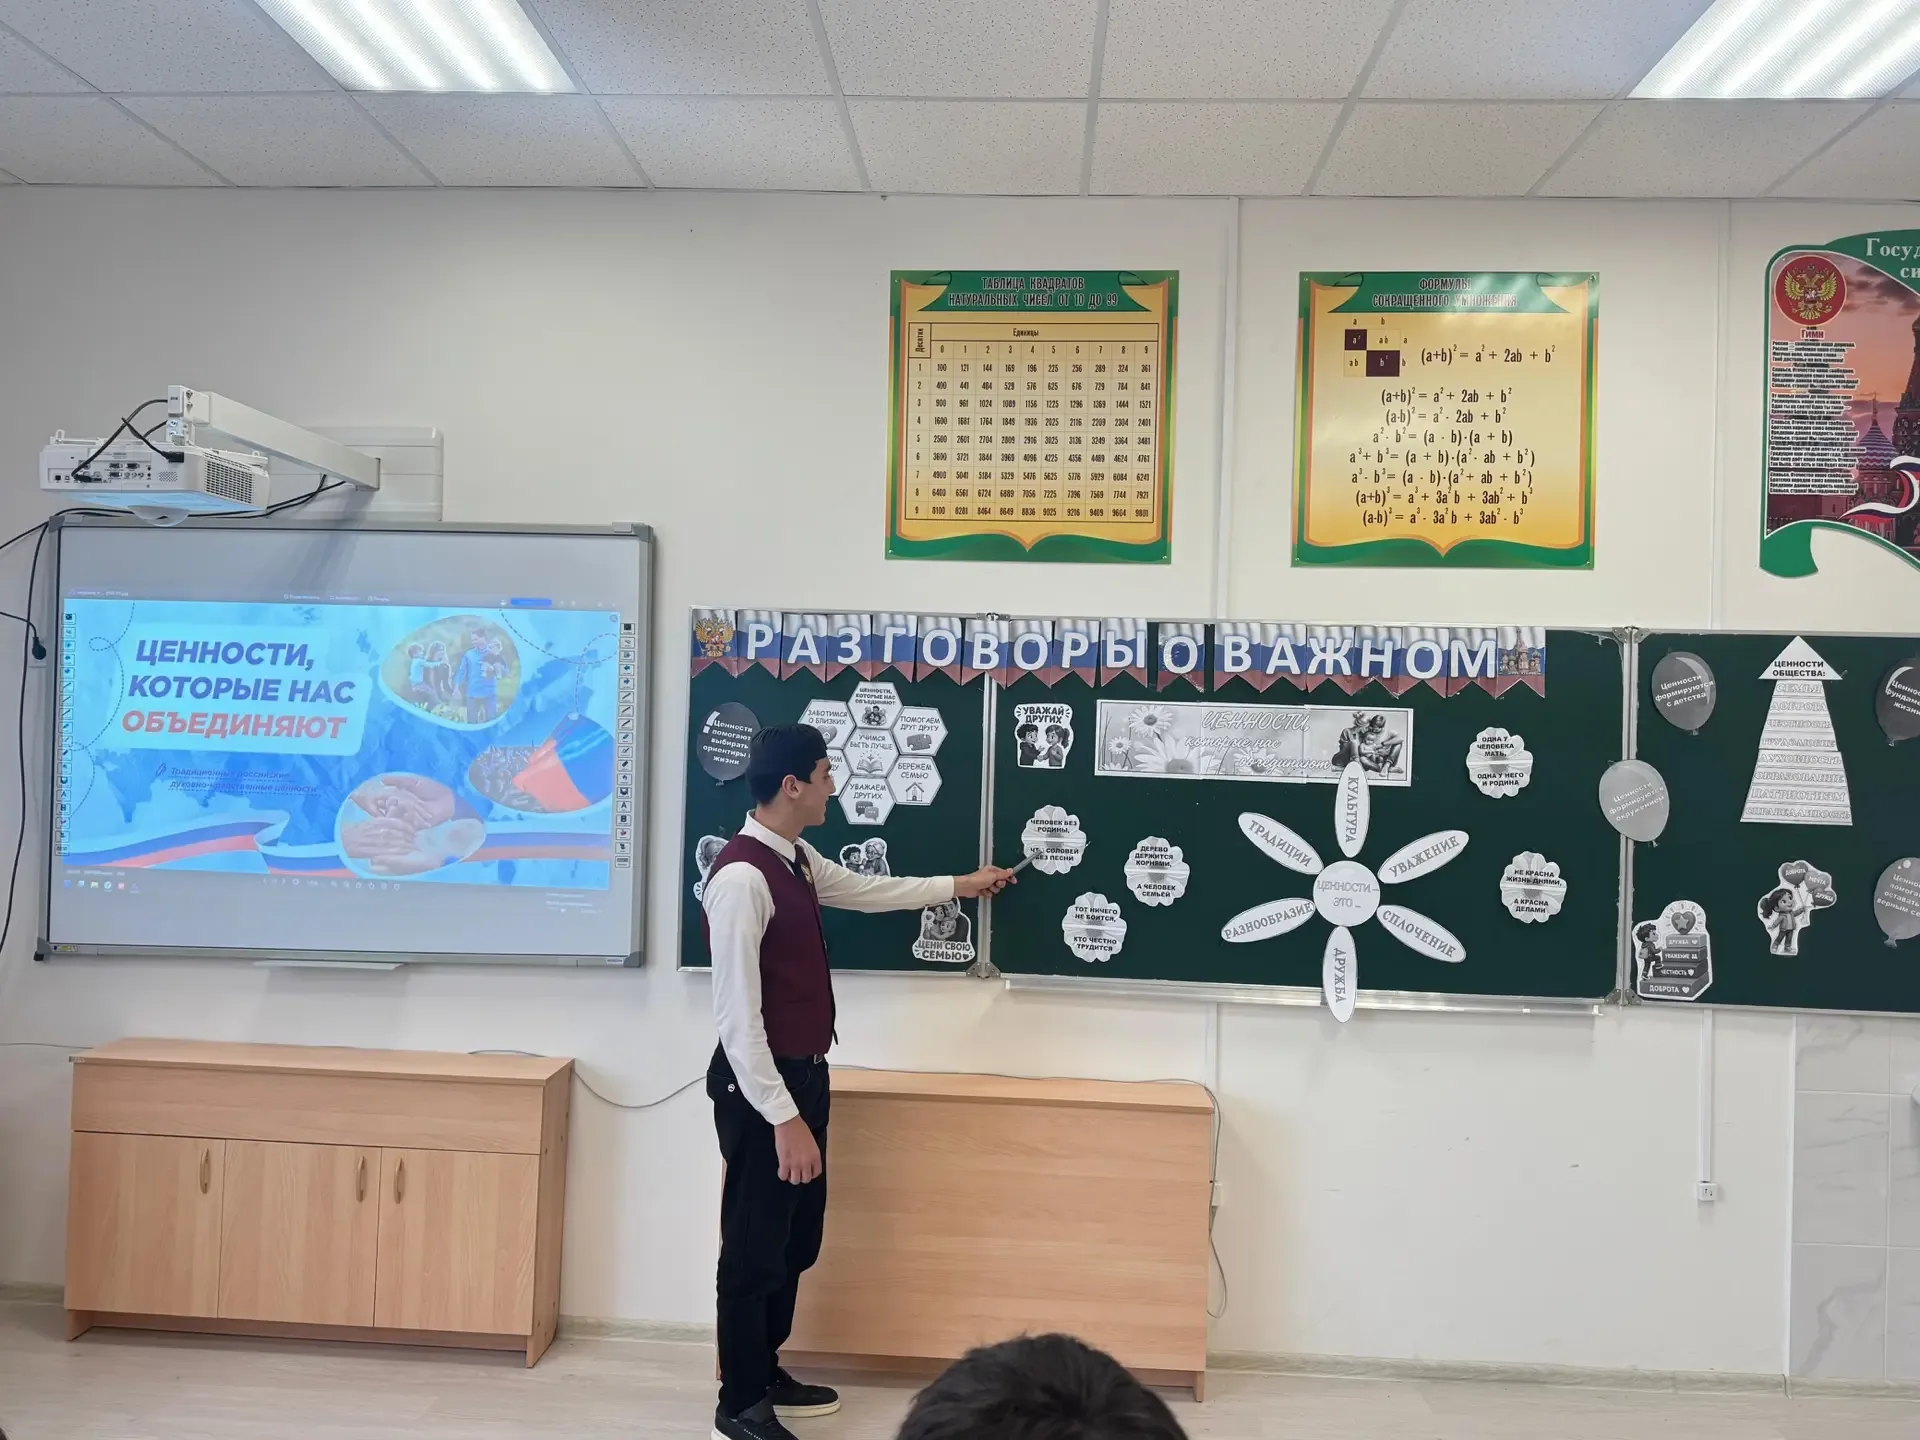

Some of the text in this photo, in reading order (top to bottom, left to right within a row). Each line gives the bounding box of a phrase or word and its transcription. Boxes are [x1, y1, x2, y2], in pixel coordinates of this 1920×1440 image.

[982, 277, 1084, 292] ТАБЛИЦА КВАДРАТОВ
[1419, 278, 1472, 290] ФОРМУЛЫ
[949, 293, 1118, 309] НАТУРАЛЬНЫХ ЧИСЕЛ ОТ 10 ДО 99
[1373, 294, 1448, 309] СОКРАЩЕННОГО
[1013, 328, 1039, 337] Единицы
[1801, 329, 1824, 340] Гимн
[915, 328, 924, 353] Десятки
[1504, 347, 1522, 363] 2ab
[960, 364, 969, 372] 121
[982, 364, 992, 372] 144
[1048, 364, 1059, 372] 225
[1072, 364, 1082, 372] 256
[1118, 365, 1128, 373] 324
[1141, 365, 1151, 373] 361
[1460, 389, 1479, 404] 2ab
[1046, 400, 1059, 409] 1225
[1455, 410, 1474, 424] 2ab
[1043, 472, 1058, 481] 5625
[1043, 489, 1126, 499] 7225 7744
[136, 638, 314, 670] ЦЕННОСТИ,
[747, 622, 1497, 680] РАЗГОВОРЫ О ВАЖНОМ
[1660, 674, 1702, 690] Ценности
[1776, 683, 1823, 693] СЕМЬЯ
[128, 675, 356, 704] КОТОРЫЕ НАС
[1655, 680, 1714, 702] формируются
[1673, 692, 1707, 706] детства
[1023, 706, 1064, 715] УВАЖАЙ
[1770, 701, 1827, 711] ДОБРОТА
[122, 710, 348, 739] ОБЪЕДИНЯЮТ
[900, 716, 940, 724] ПОМОГАЕМ
[1025, 715, 1062, 724] ДРУГИХ
[1202, 710, 1311, 732] ЦЕННОСТИ,
[1767, 719, 1831, 728] ЧЕСТНОСТЬ
[714, 720, 752, 732] Ценности
[712, 730, 751, 740] помогают
[711, 738, 748, 749] выбирать
[871, 742, 893, 750] ЛУЧШЕ
[1184, 735, 1281, 750] которые нас
[1762, 737, 1836, 747] ТРУДОЛЮБИЕ
[703, 745, 746, 758] ориентиры
[713, 756, 740, 764] жизни
[1239, 751, 1331, 777] объединяют
[1759, 753, 1841, 765] ДУХОВНОСТЬ
[898, 762, 932, 770] БЕРЕЖЕМ
[1754, 771, 1845, 783] ОБРАЗОВАНИЕ
[1613, 782, 1652, 803] Ценности
[1751, 788, 1846, 801] ПАТРИОТИЗМ
[1608, 786, 1664, 815] формируются
[1345, 776, 1359, 843] КУЛЬТУРА
[1615, 795, 1665, 821] окружением
[1745, 807, 1850, 819] СПРАВЕДЛИВОСТЬ
[1248, 819, 1314, 868] ТРАДИЦИИ
[1388, 836, 1461, 877] УВАЖЕНИЕ
[1525, 870, 1554, 878] КРАСНА
[1532, 878, 1562, 886] ДНЯМИ,
[1808, 876, 1826, 885] МЕЧТА
[1876, 898, 1908, 912] верным
[1224, 901, 1315, 940] РАЗНООБРАЗИЕ
[1382, 909, 1456, 959] СПЛОЧЕНИЕ
[918, 940, 970, 951] ЦЕНИ СВОЮ
[922, 950, 962, 960] СЕМЬЮ
[1334, 947, 1347, 1004] ДРУЖБА
[1649, 985, 1679, 993] ДОБРОТА
